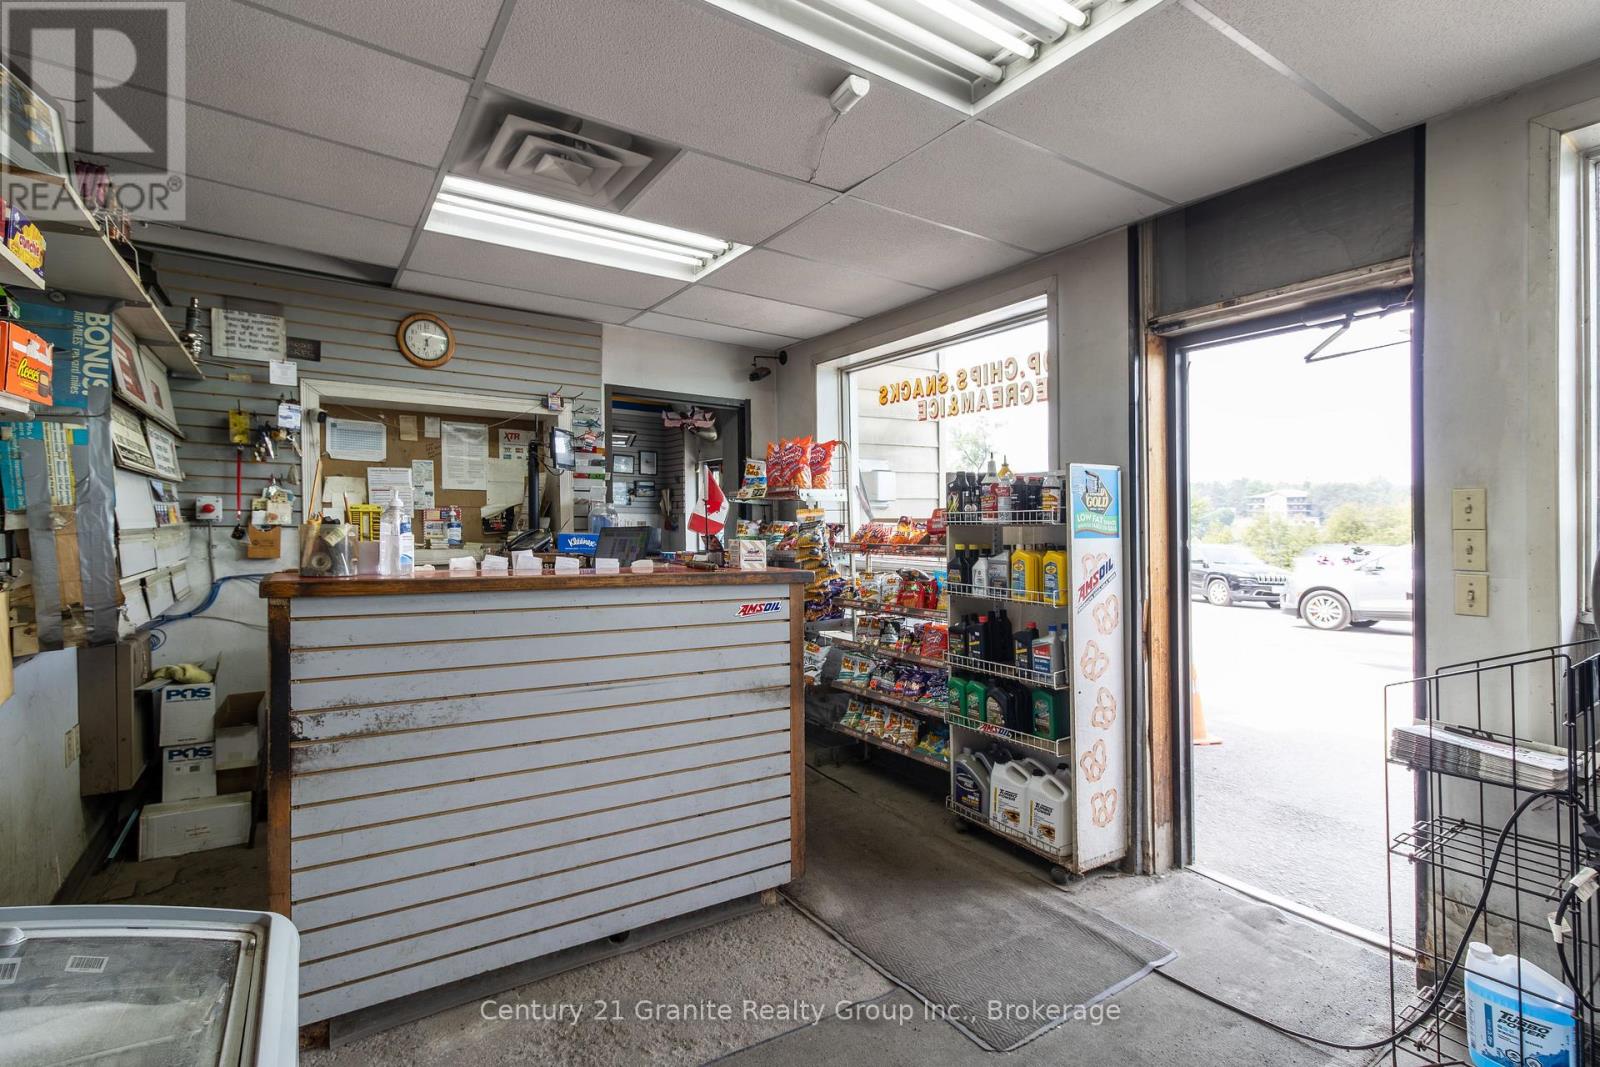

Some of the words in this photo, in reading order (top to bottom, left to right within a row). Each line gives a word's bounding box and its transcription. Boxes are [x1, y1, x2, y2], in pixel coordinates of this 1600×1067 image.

[503, 431, 520, 442] XTR
[1086, 496, 1109, 508] GOLD
[1077, 512, 1092, 522] LOW
[1077, 557, 1114, 603] AMSOIL
[737, 601, 781, 616] AMSOIL
[1497, 1018, 1547, 1039] POWER
[1500, 1010, 1552, 1034] TURBO
